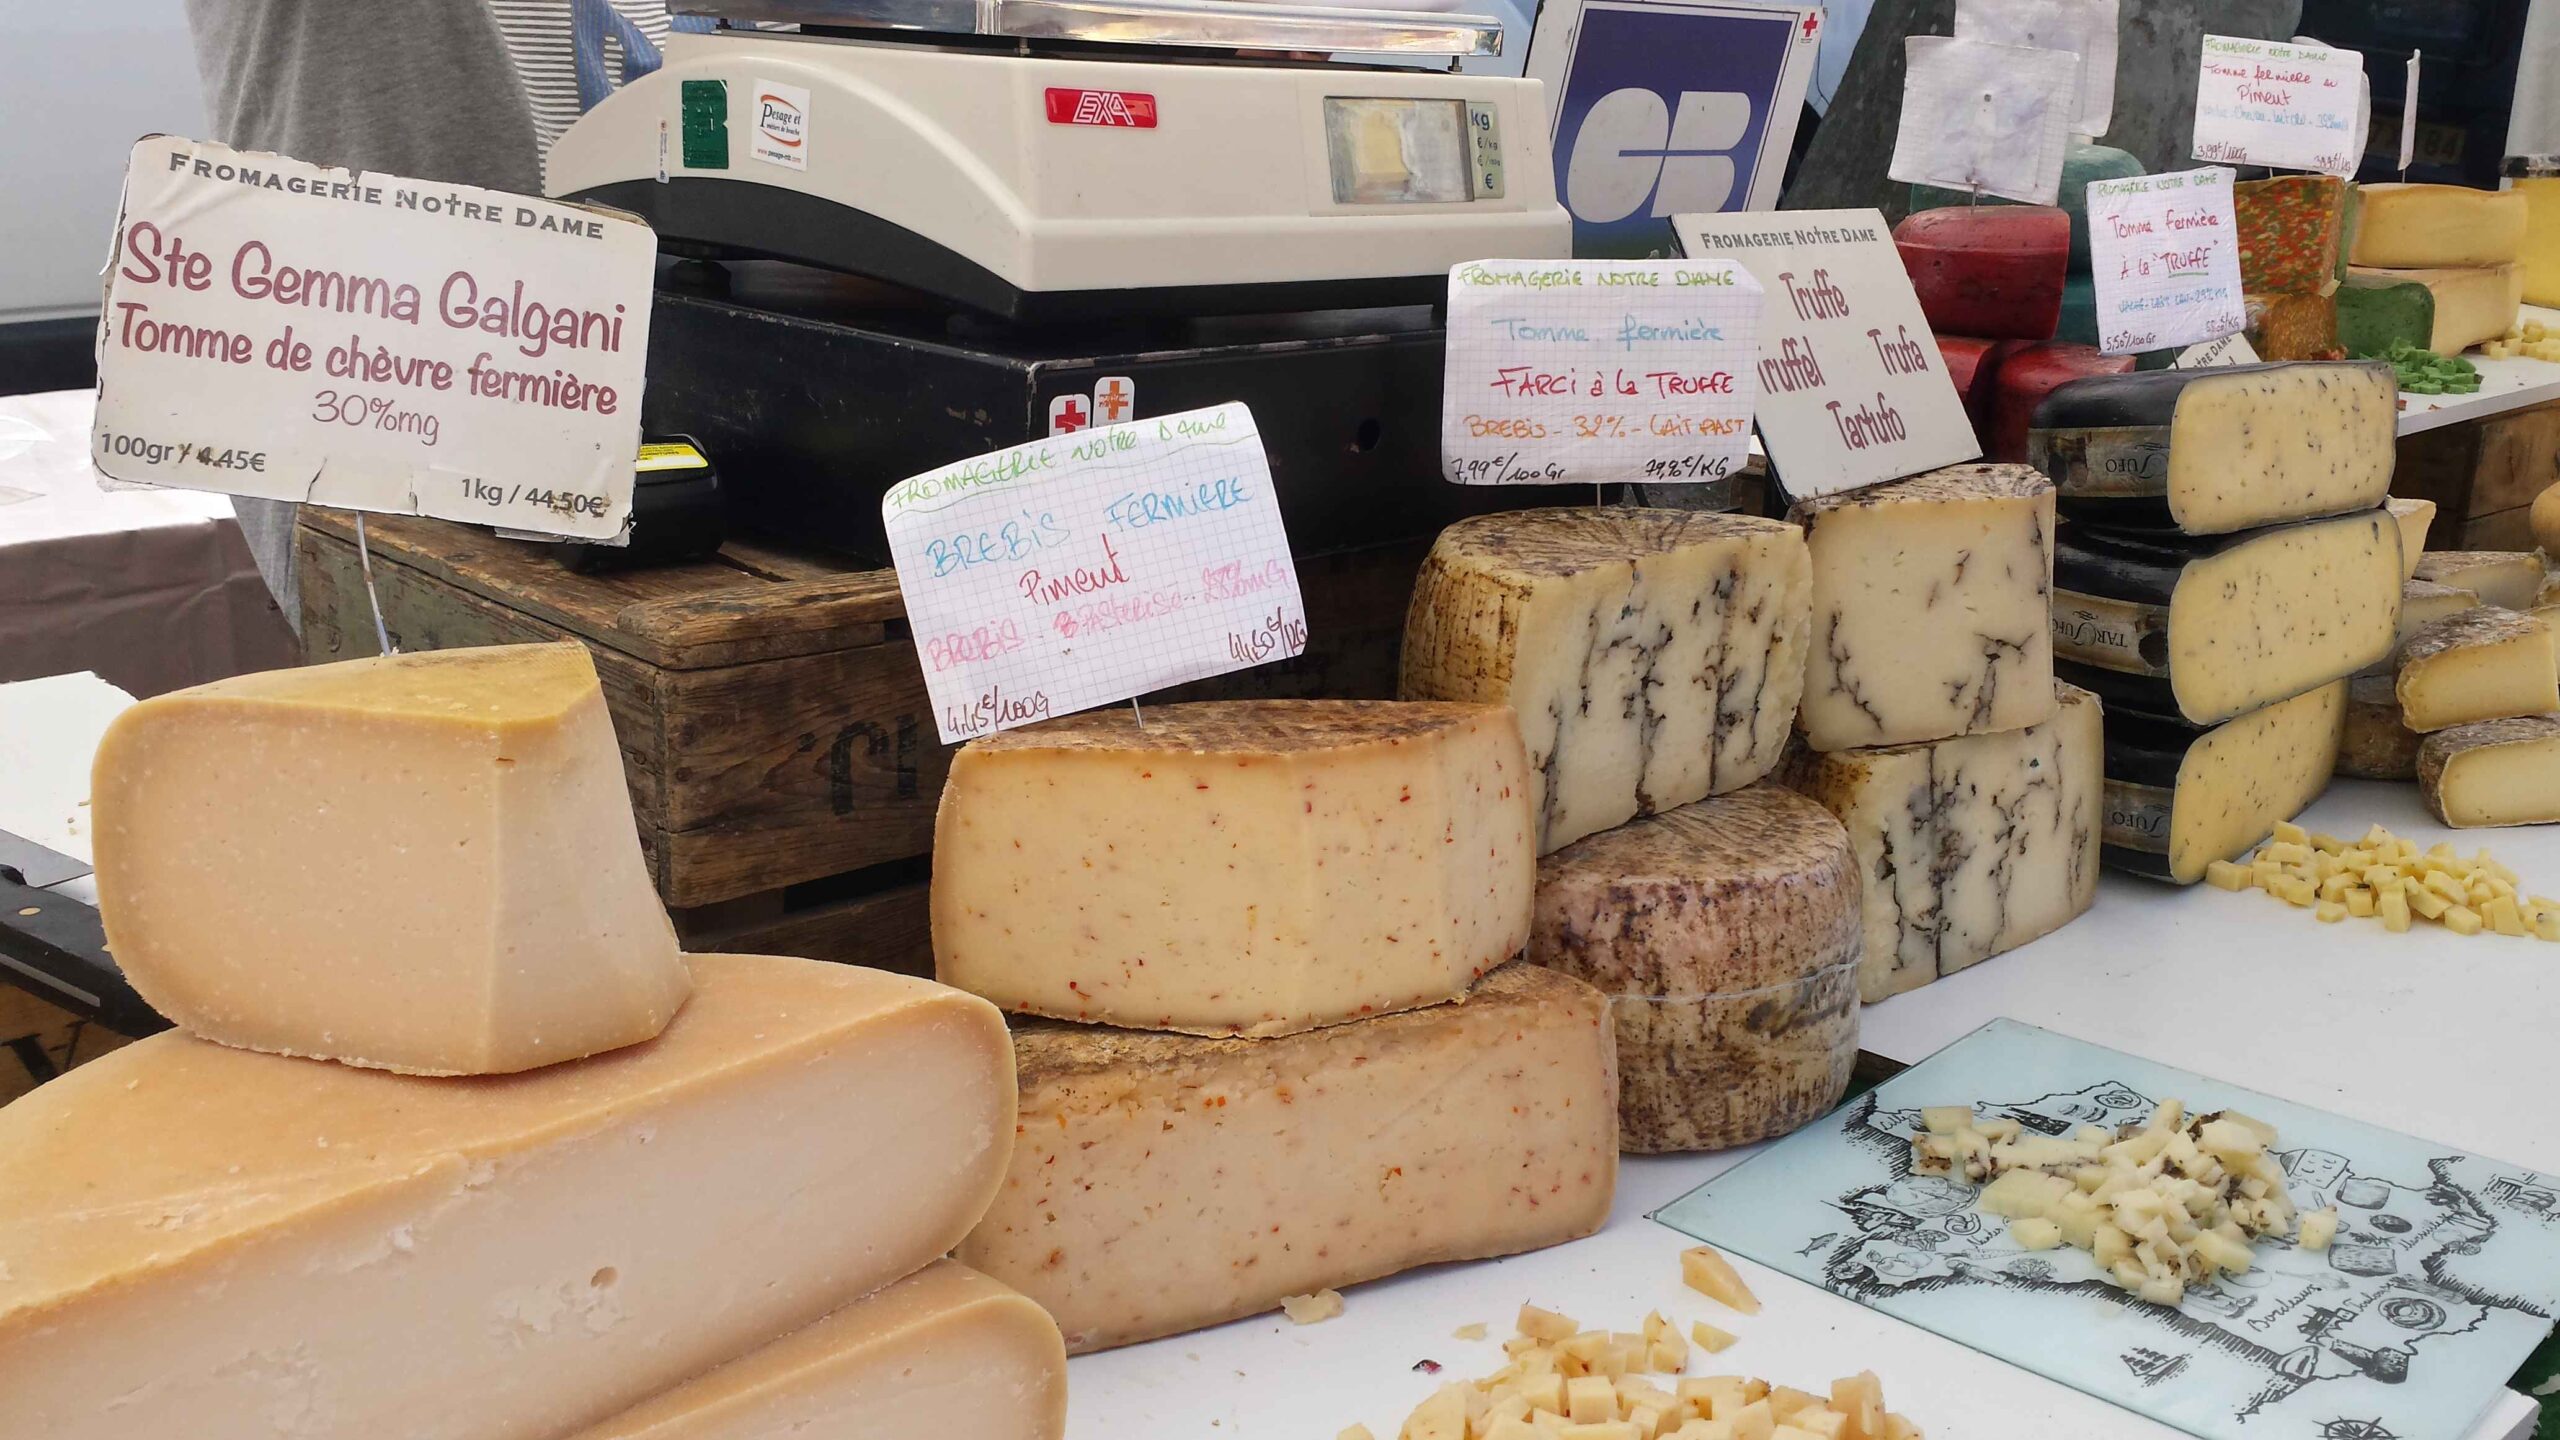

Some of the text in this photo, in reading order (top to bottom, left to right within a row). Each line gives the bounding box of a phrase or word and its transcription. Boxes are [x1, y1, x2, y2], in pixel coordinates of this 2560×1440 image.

[1072, 91, 1135, 126] EXA
[2237, 83, 2292, 106] Piment
[760, 103, 802, 128] Pesage et
[1470, 109, 1490, 131] kg
[1477, 137, 1498, 151] €/kg
[169, 152, 604, 240] FROMAGERIE NOTRE DAME
[1485, 173, 1493, 190] €
[2194, 173, 2218, 187] DAME
[1700, 226, 1878, 250] FROMAGERIE NOTRE DAME
[2107, 214, 2153, 239] Tomme
[121, 220, 626, 358] Ste Gemma Galgani
[1597, 270, 1660, 288] NOTRE
[1676, 270, 1735, 287] DAME
[1779, 268, 1850, 322] Truffe
[1491, 313, 1725, 351] Tomme fermière
[1867, 324, 1929, 376] Trufa
[116, 302, 618, 416] Tomme de chèvre fermière
[1590, 371, 1604, 397] à
[1616, 368, 1640, 395] la
[1646, 371, 1735, 400] TRUFFE
[311, 389, 440, 447] 30%mg
[1699, 418, 1746, 437] PAST
[1825, 392, 1907, 451] Tartufo
[101, 434, 175, 468] 100gr
[197, 446, 267, 474] 4.45€
[461, 478, 605, 518] 1kg / 44.50€
[1019, 533, 1130, 605] Piment
[2247, 1283, 2322, 1333] Bordeaux
